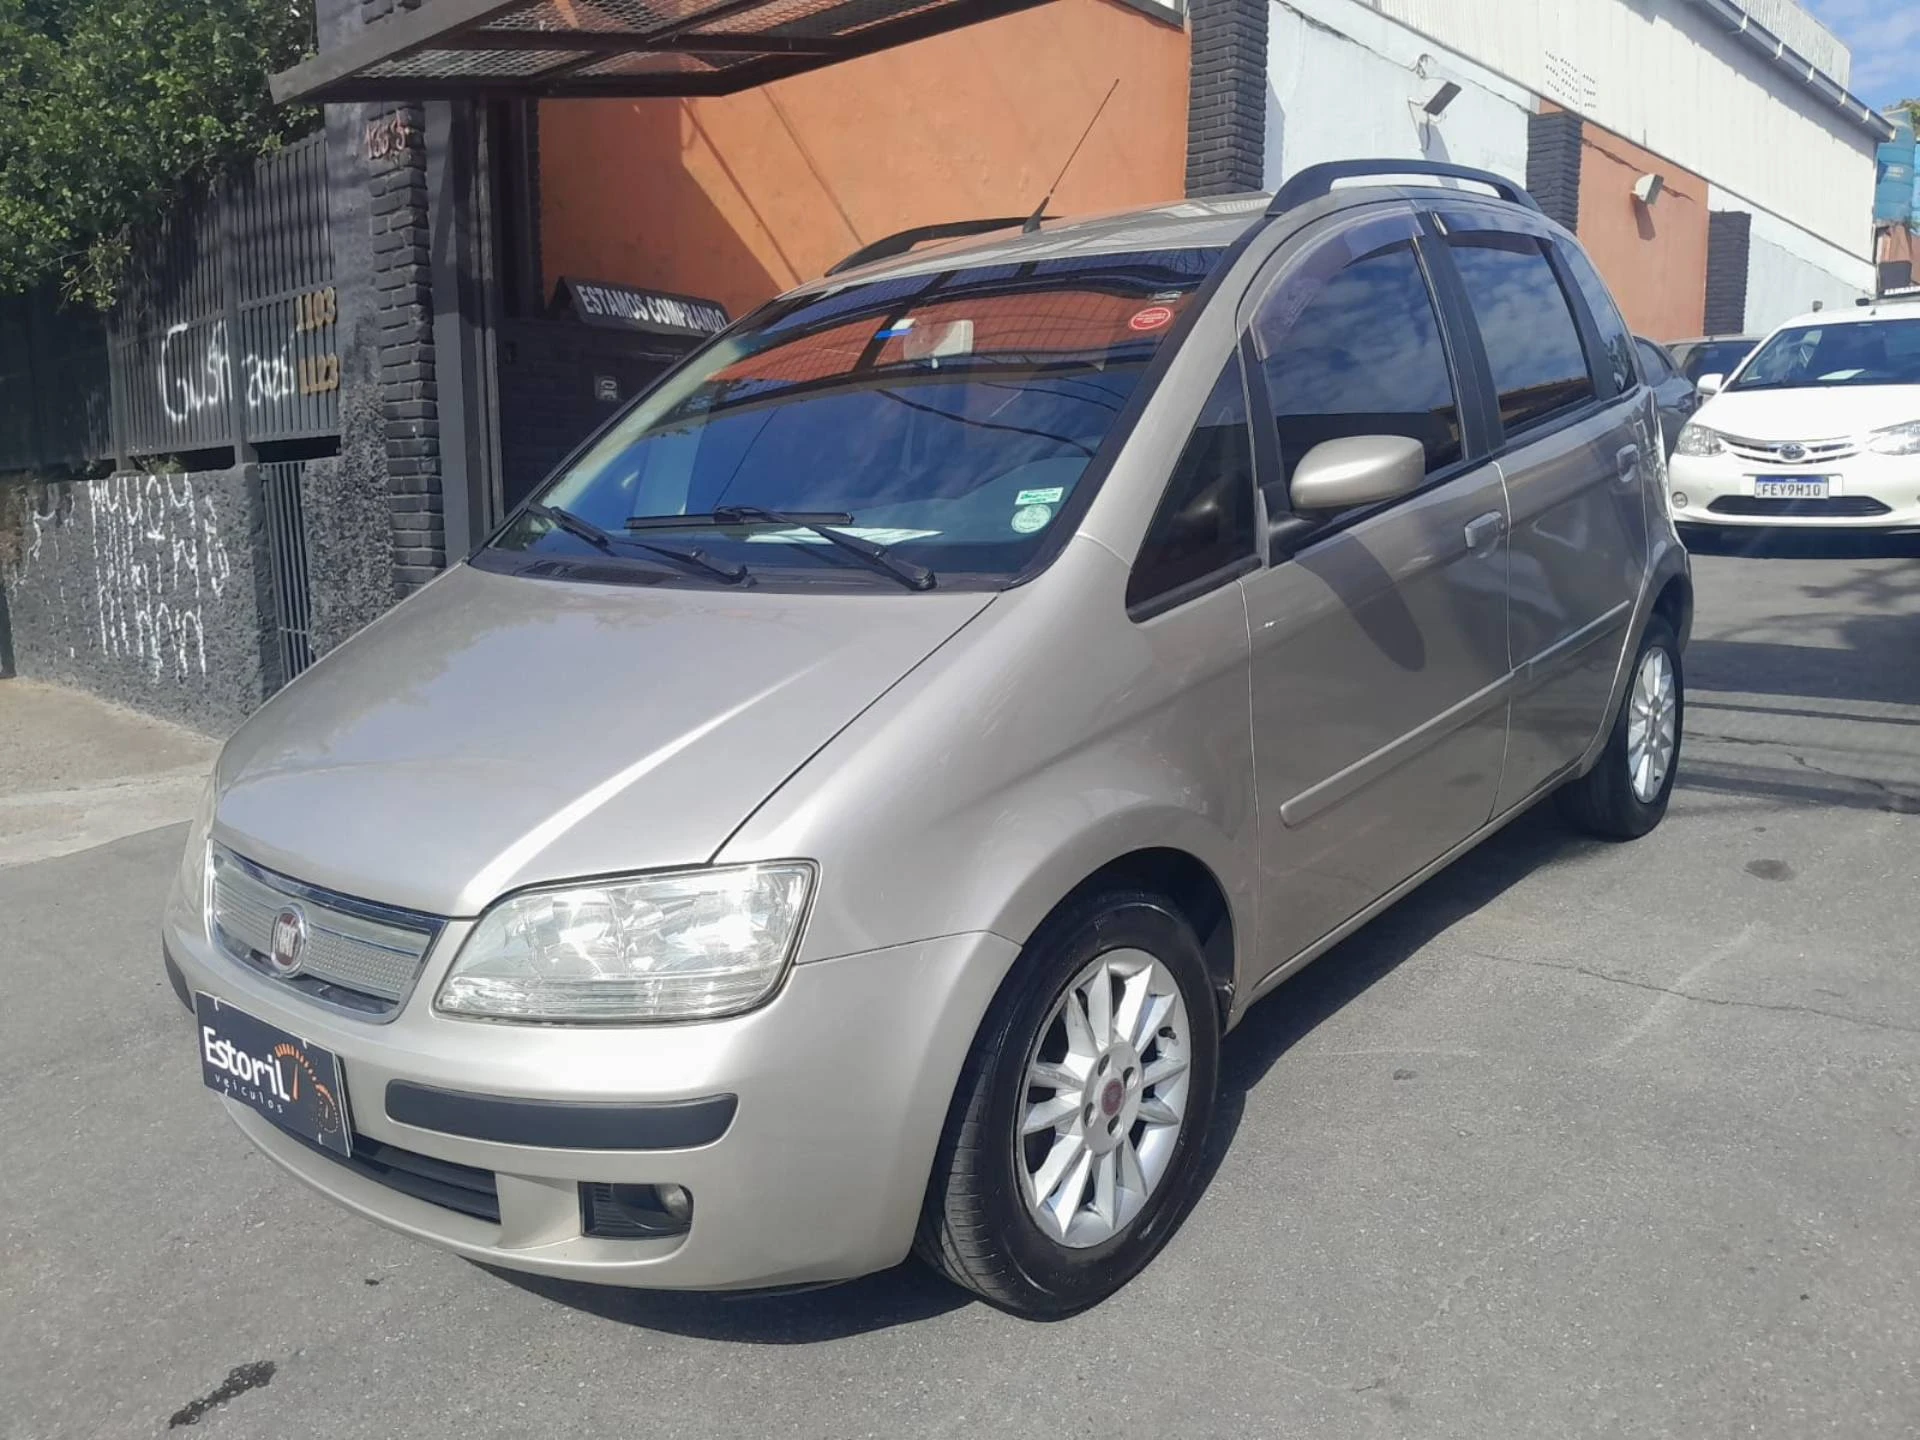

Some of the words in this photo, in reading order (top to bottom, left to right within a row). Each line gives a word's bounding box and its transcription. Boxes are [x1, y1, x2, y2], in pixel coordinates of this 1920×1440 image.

[296, 286, 337, 332] 1103
[576, 285, 650, 321] ESTAMOS
[645, 296, 728, 332] COMPRANDO
[1762, 483, 1821, 497] FEY9H10
